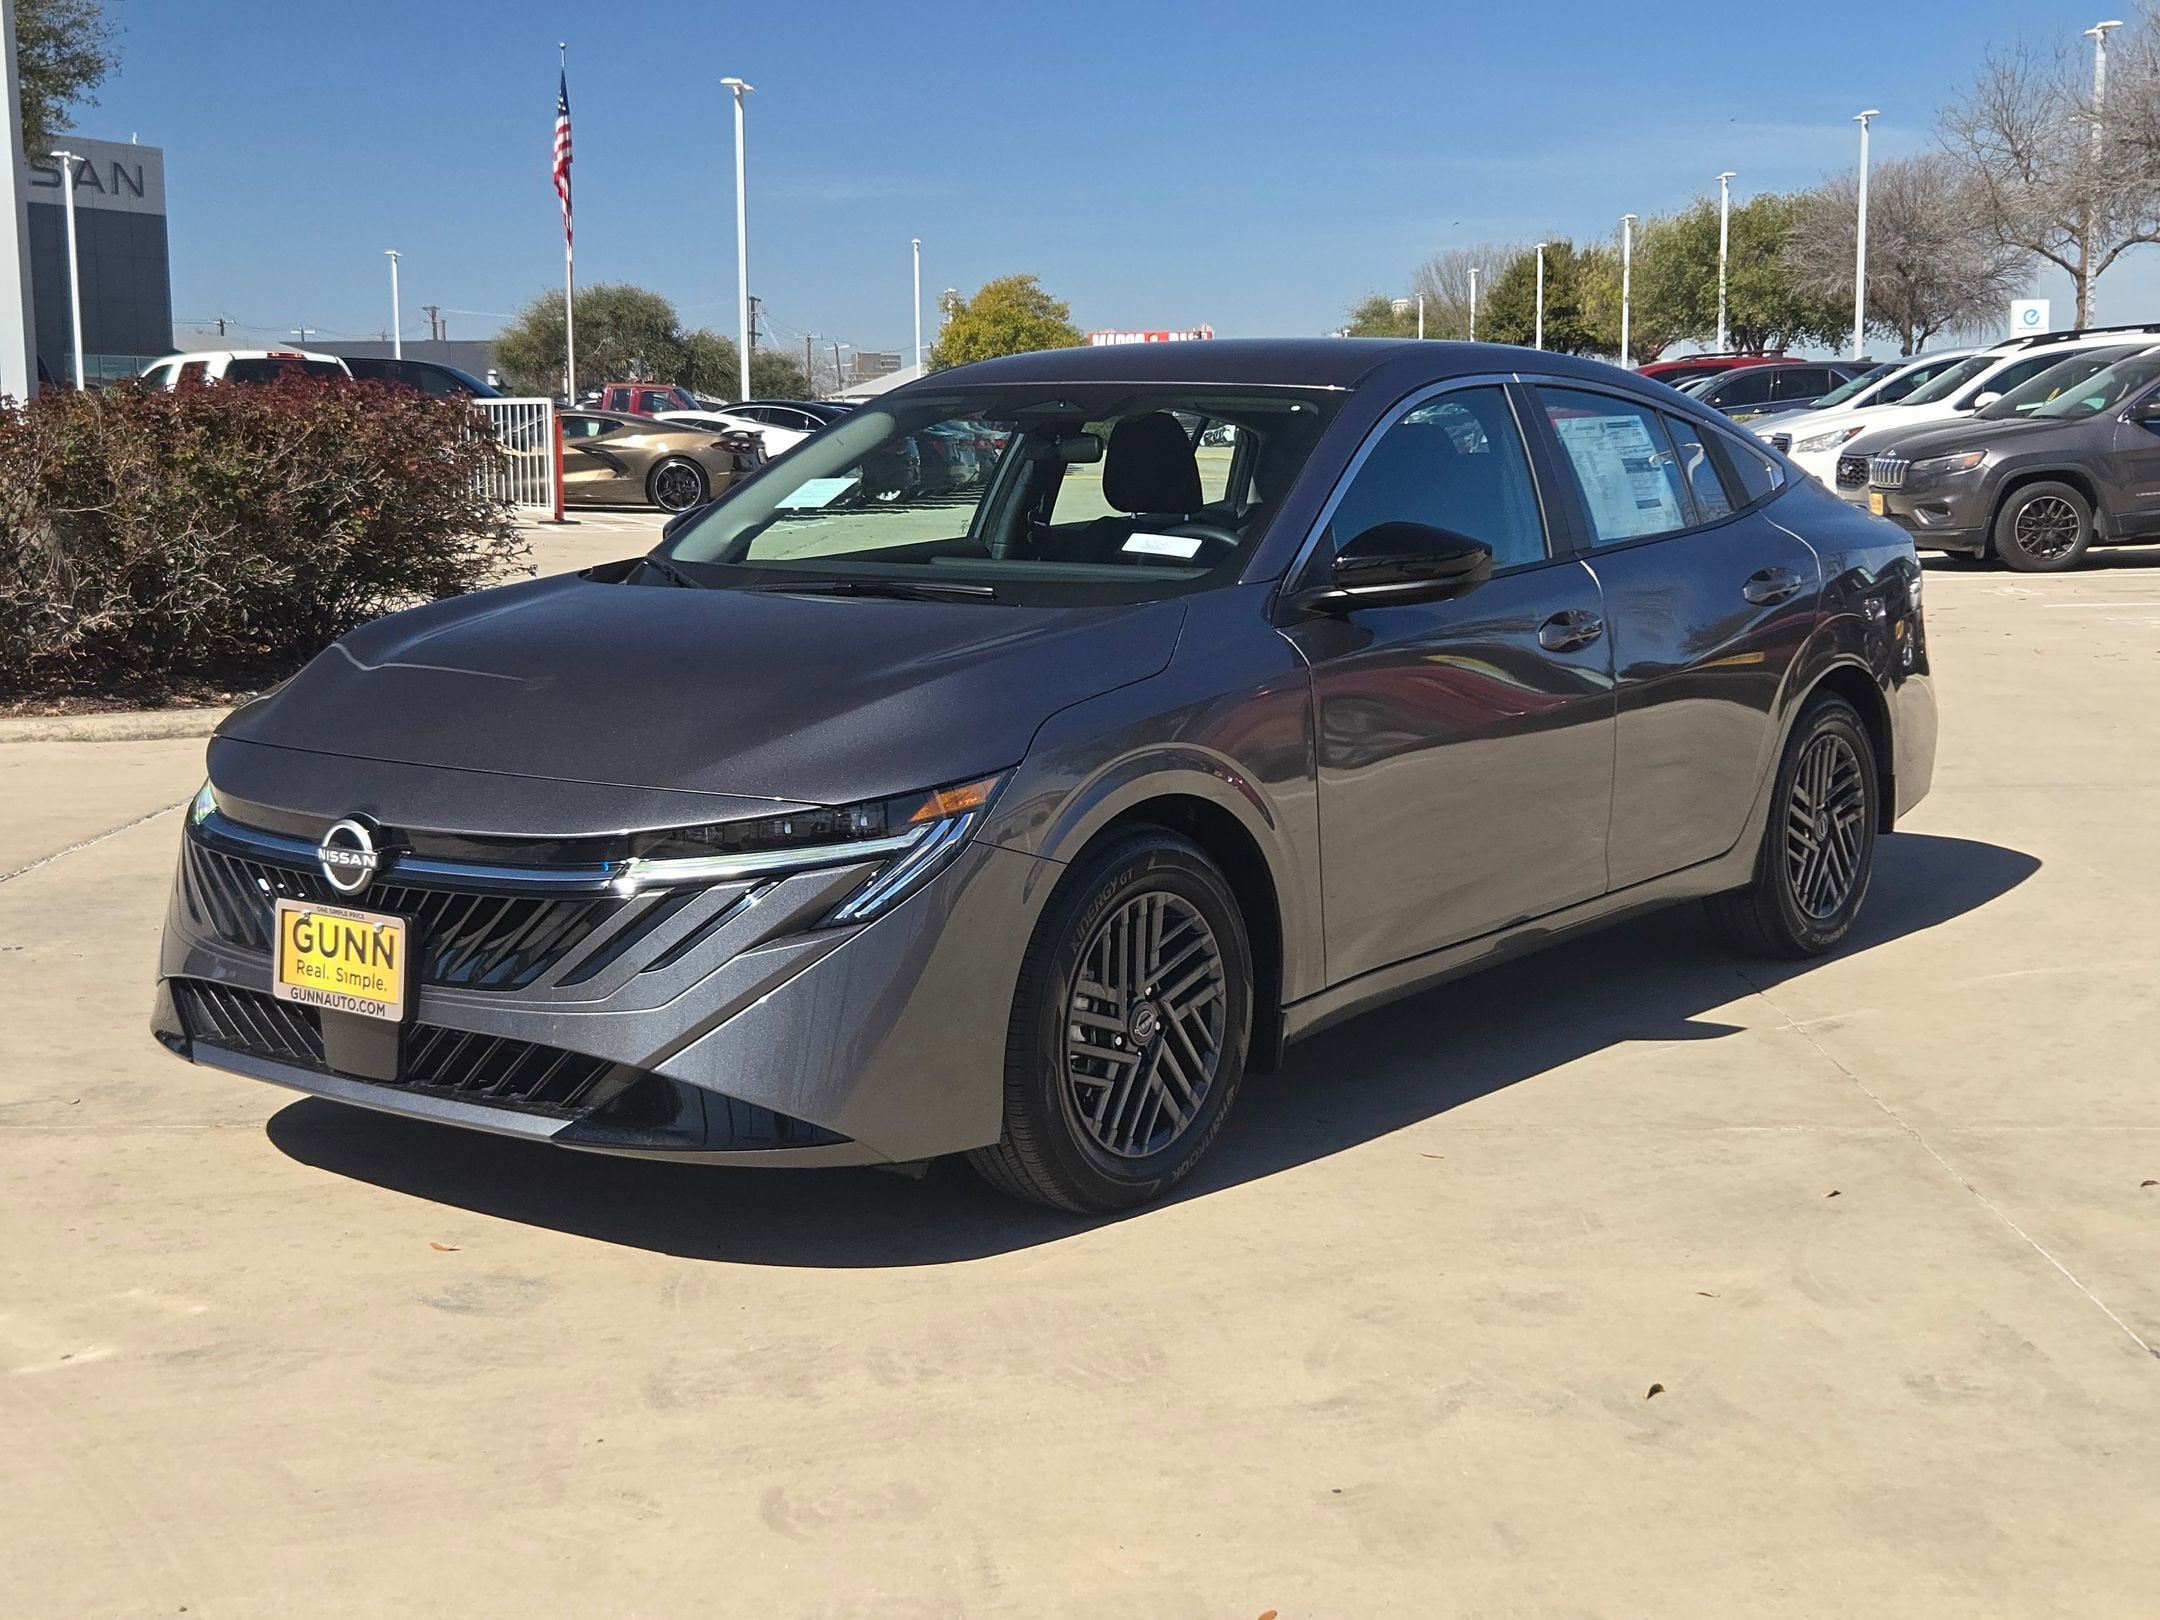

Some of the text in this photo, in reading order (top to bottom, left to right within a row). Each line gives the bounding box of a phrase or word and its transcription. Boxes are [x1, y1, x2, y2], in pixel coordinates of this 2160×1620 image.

[318, 848, 377, 867] NISSAN
[316, 906, 365, 920] ONE SIMPLE PRICE
[292, 917, 395, 970] GUNN
[296, 959, 388, 992] Real. Simple.
[290, 986, 386, 1017] GUNNAUTO.COM
